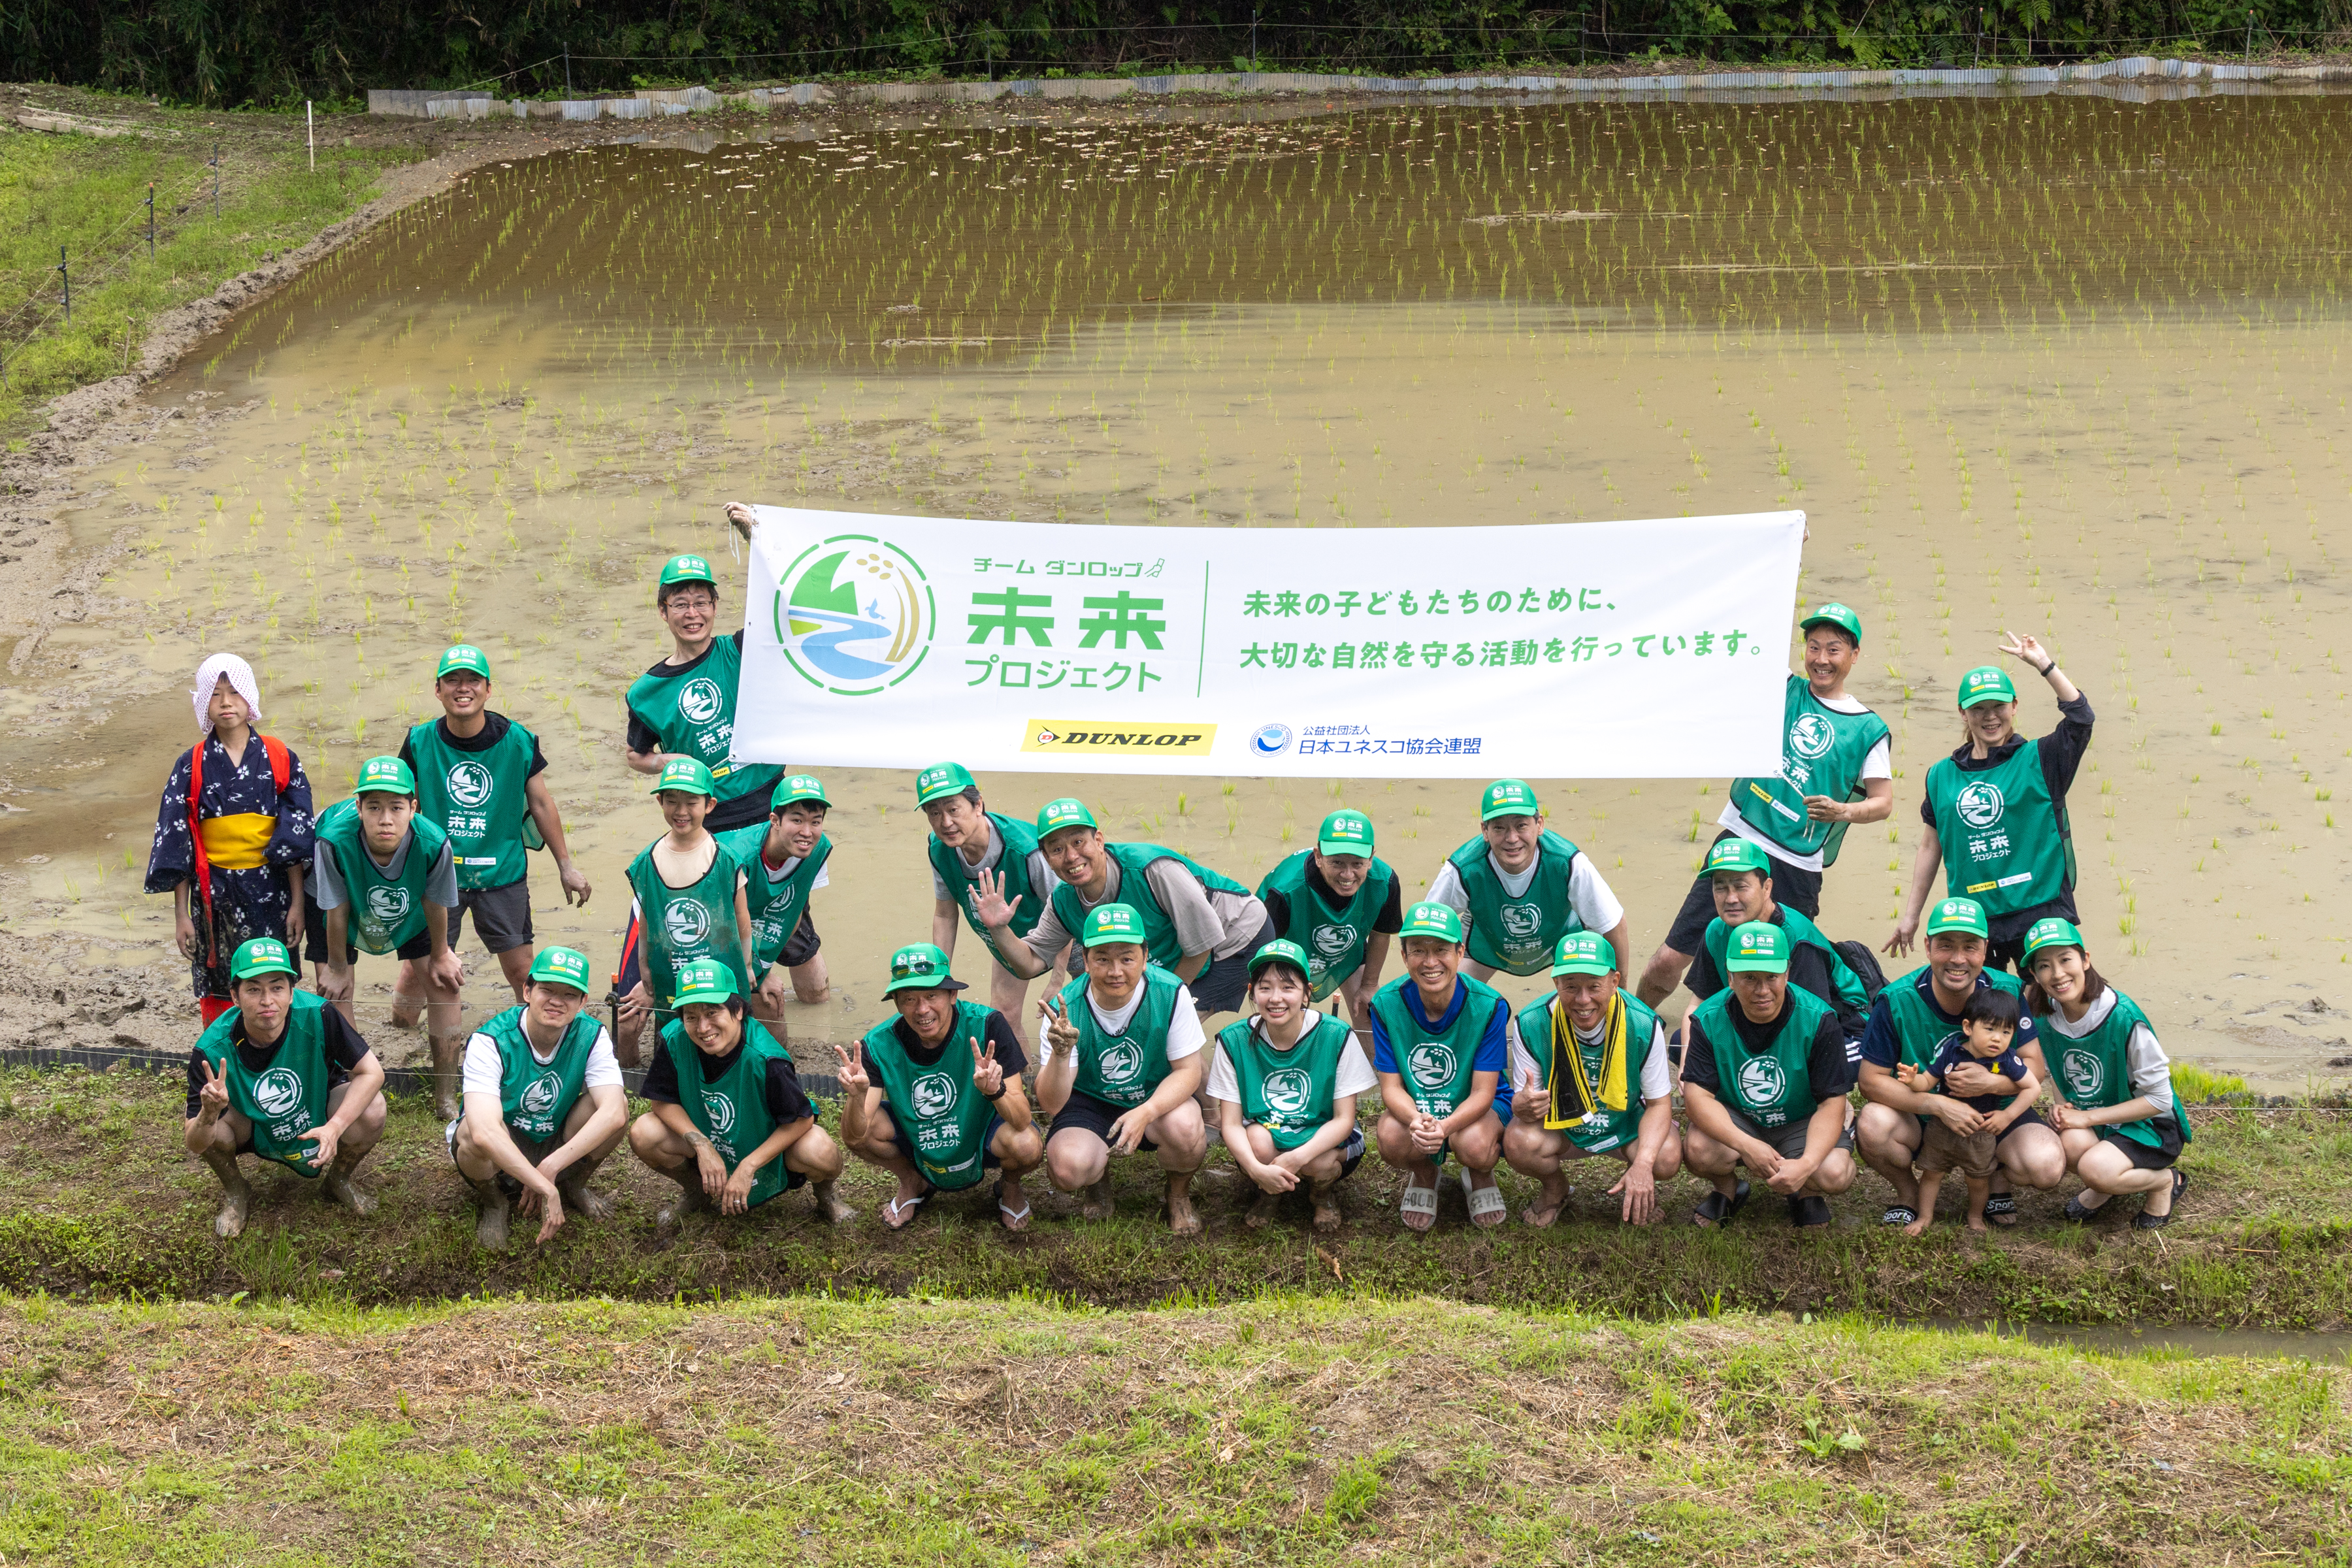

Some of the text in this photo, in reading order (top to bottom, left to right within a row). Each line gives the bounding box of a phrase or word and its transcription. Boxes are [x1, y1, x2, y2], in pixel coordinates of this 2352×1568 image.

[973, 558, 1143, 577] チーム ダンロップ
[1243, 587, 1616, 617] 未来の子どもたちのために、
[966, 587, 1166, 650] 未来
[1240, 629, 1760, 669] 大切な自然を守る活動を行っています。
[965, 654, 1162, 692] プロジェクト
[698, 723, 733, 749] 未来
[1062, 732, 1202, 745] DUNLOP
[1303, 725, 1371, 736] 公益社団法人
[704, 738, 732, 756] プロジェク
[1299, 738, 1482, 755] 日本ユネスコ協会連盟
[1752, 785, 1770, 800] DUNLOP
[448, 816, 486, 830] 未来
[448, 828, 485, 838] プロジェクト
[1970, 836, 2009, 853] 未来
[1972, 849, 2011, 862] プロジェクト
[752, 930, 779, 944] ロジェクト
[1416, 1099, 1452, 1113] 未来
[272, 1110, 310, 1137] 未来
[512, 1117, 554, 1132] 未来
[919, 1124, 959, 1142] 未来
[920, 1139, 960, 1151] プロジェクト
[1403, 1191, 1433, 1209] GOOD
[1987, 1200, 2015, 1209] Sport
